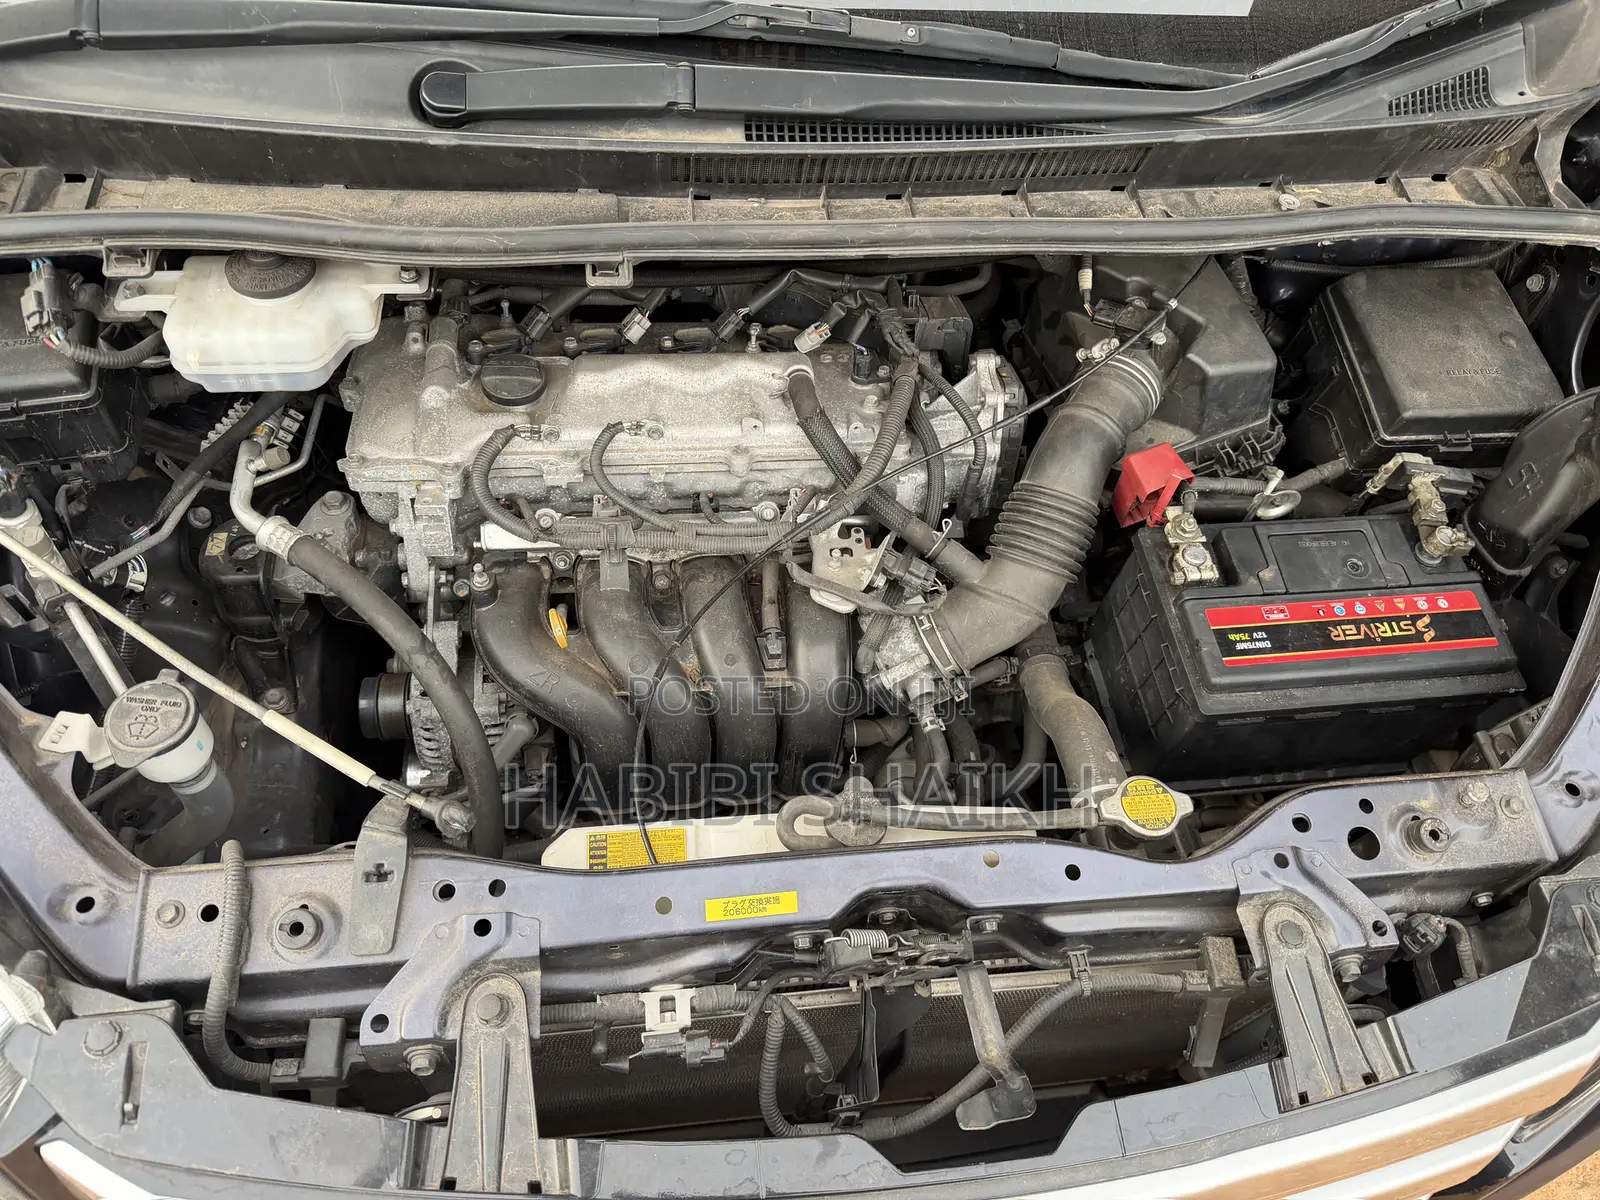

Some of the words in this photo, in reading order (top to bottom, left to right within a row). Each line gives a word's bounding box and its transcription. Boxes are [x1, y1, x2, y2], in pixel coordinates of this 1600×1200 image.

[1445, 368, 1471, 376] RELAY
[1228, 632, 1251, 641] 75Ah
[1253, 631, 1268, 639] 12V
[1235, 640, 1272, 650] DIN75MF
[526, 663, 560, 695] ZR
[126, 696, 157, 706] WASHER
[160, 700, 182, 708] FLUID
[141, 705, 161, 713] ONLY
